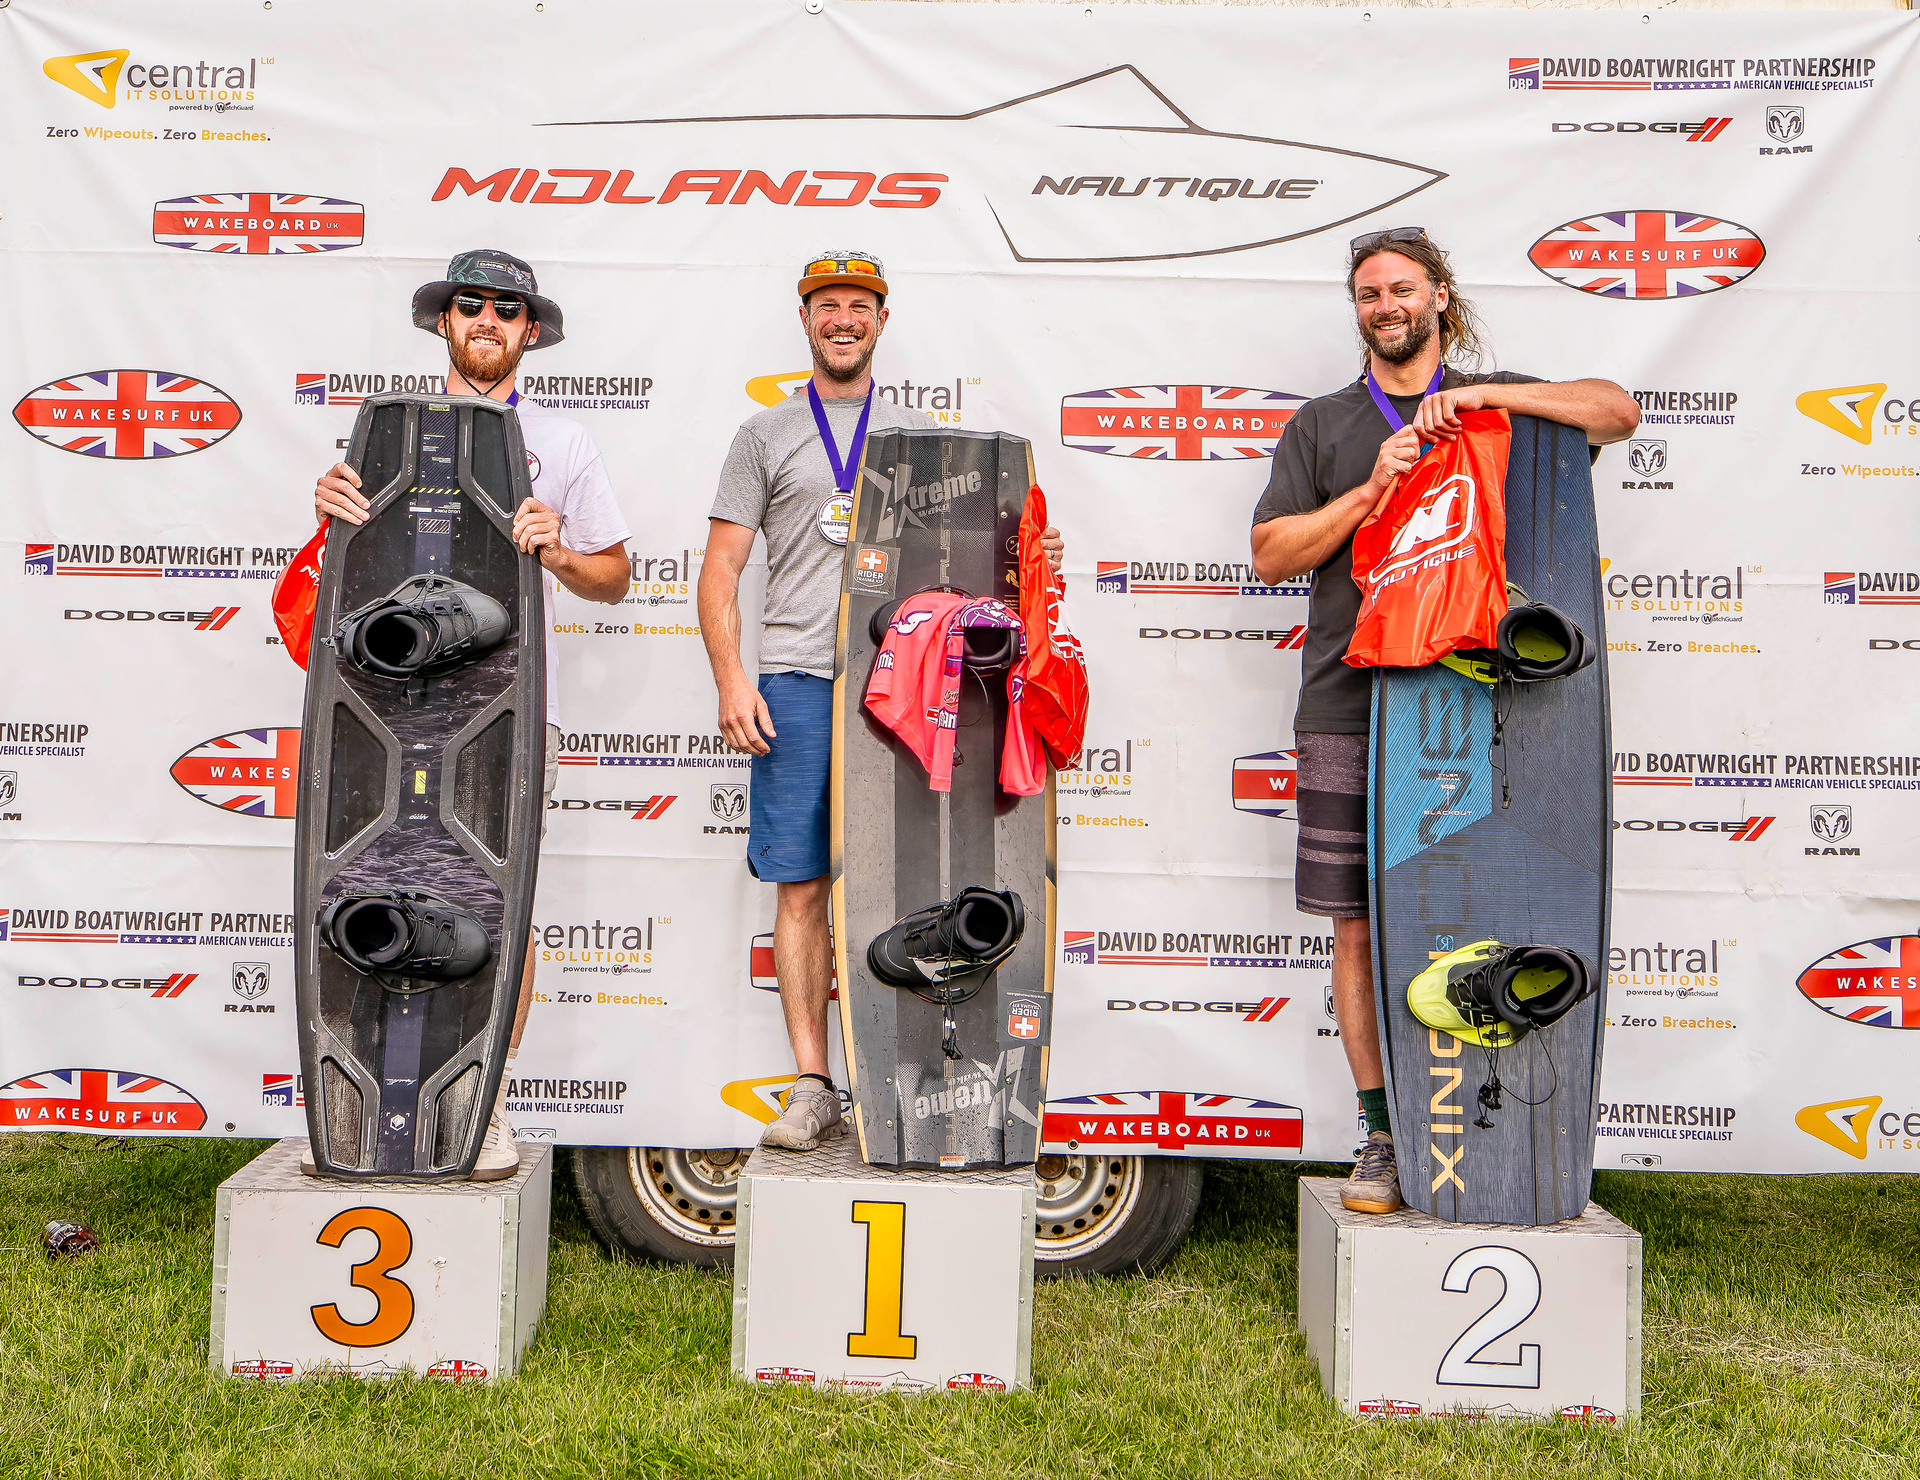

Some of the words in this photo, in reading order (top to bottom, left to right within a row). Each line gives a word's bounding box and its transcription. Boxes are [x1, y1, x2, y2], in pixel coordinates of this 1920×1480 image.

[127, 58, 256, 89] central
[260, 57, 275, 65] Ltd
[1542, 58, 1601, 78] DAVID
[1607, 58, 1736, 79] BOATWRIGHT
[1743, 57, 1876, 78] PARTNERSHIP
[1510, 76, 1535, 90] DBP
[1733, 80, 1780, 90] AMERICAN
[1782, 80, 1819, 91] VEHICLE
[1821, 78, 1875, 91] SPECIALIST
[127, 90, 142, 101] IT
[149, 89, 255, 101] SOLUTIONS
[169, 104, 202, 112] powered
[204, 104, 213, 112] by
[46, 127, 79, 138] Zero
[84, 127, 158, 140] Wipeouts.
[163, 129, 197, 140] Zero
[201, 129, 271, 142] Breaches.
[1552, 122, 1707, 134] DODGE
[1759, 145, 1814, 155] RAM
[431, 167, 949, 209] MIDLANDS
[183, 216, 321, 231] WAKEBOARD
[326, 221, 339, 230] UK
[1569, 247, 1703, 262] WAKESURF
[1712, 245, 1739, 260] UK
[329, 374, 386, 393] DAVID
[524, 375, 653, 398] PARTNERSHIP
[296, 393, 320, 405] DBP
[879, 377, 962, 410] ntral
[967, 377, 981, 385] Ltd
[562, 399, 599, 409] VEHICLE
[601, 398, 649, 410] SPECIALIST
[1635, 391, 1738, 412] RTNERSHIP
[52, 407, 180, 422] WAKESURF
[189, 409, 214, 423] UK
[1645, 414, 1682, 425] VEHICLE
[1684, 414, 1735, 426] SPECIALIST
[1096, 414, 1265, 431] WAKEBOARD
[1271, 421, 1286, 430] UK
[1883, 425, 1900, 435] IT
[1801, 463, 1836, 475] Zero
[1841, 464, 1920, 479] Wipeouts.
[1622, 481, 1674, 490] RAM
[831, 504, 850, 521] 1s
[57, 543, 115, 565] DAVID
[120, 545, 245, 567] BOATWRIGHT
[25, 562, 48, 576] DBP
[630, 549, 689, 582] tral
[1131, 561, 1190, 582] DAVID
[240, 569, 280, 580] AMERICA
[857, 569, 884, 580] RIDER
[632, 583, 689, 594] TIONS
[1097, 581, 1121, 593] DBP
[1607, 566, 1743, 600] central
[1747, 564, 1762, 574] Ltd
[1858, 572, 1920, 592] DAVID
[637, 598, 647, 607] by
[1825, 592, 1850, 604] DBP
[1607, 600, 1624, 611] IT
[1630, 600, 1743, 612] SOLUTIONS
[64, 609, 213, 622] DODGE
[1652, 614, 1688, 623] powered
[1690, 614, 1700, 624] by
[553, 623, 590, 635] outs.
[594, 622, 629, 635] Zero
[1139, 627, 1293, 641] DODGE
[1607, 640, 1642, 652] outs.
[1646, 640, 1683, 653] Zero
[1687, 641, 1761, 654] Breaches.
[0, 724, 89, 744] TNERSHIP
[1136, 738, 1151, 747] Ltd
[35, 746, 86, 757] SPECIALIST
[677, 757, 725, 768] AMERICAN
[1646, 753, 1778, 775] BOATWRIGHT
[1785, 755, 1920, 777] PARTNERSHIP
[210, 765, 291, 779] WAKES
[1060, 774, 1132, 786] UTIONS
[1774, 778, 1824, 789] AMERICAN
[1825, 778, 1868, 789] VEHICLE
[1869, 779, 1920, 791] SPECIALIST
[1078, 787, 1089, 797] by
[561, 800, 650, 811] DGE
[1076, 814, 1149, 828] Breaches.
[1614, 820, 1750, 833] ODGE
[703, 825, 750, 834] RAM
[1804, 847, 1861, 856] RAM
[12, 909, 69, 930] DAVID
[75, 910, 203, 932] BOATWRIGHT
[210, 913, 294, 933] PARTNER
[658, 916, 672, 925] Ltd
[199, 936, 247, 947] AMERICAN
[249, 936, 286, 947] VEHICLE
[1098, 931, 1157, 952] DAVID
[1163, 932, 1292, 955] BOATWRIGHT
[542, 950, 653, 963] SOLUTIONS
[1065, 952, 1089, 964] DBP
[1608, 939, 1718, 974] entral
[1722, 939, 1737, 947] Ltd
[563, 965, 598, 974] powered
[600, 965, 610, 975] by
[1289, 959, 1332, 969] AMERICA
[18, 976, 171, 989] DODGE
[1837, 976, 1918, 990] WAKES
[557, 991, 592, 1003] Zero
[597, 991, 668, 1006] Breaches.
[1626, 988, 1662, 998] powered
[1664, 989, 1674, 998] by
[224, 1004, 276, 1013] RAM
[1011, 1008, 1039, 1018] RIDER
[1107, 1000, 1263, 1013] DODGE
[1621, 1015, 1657, 1028] Zero
[1662, 1017, 1737, 1029] Breaches.
[506, 1079, 628, 1101] ARTNERSHIP
[263, 1094, 287, 1107] DBP
[505, 1101, 533, 1112] RICAN
[535, 1102, 572, 1113] VEHICLE
[574, 1103, 624, 1114] SPECIALIST
[15, 1107, 142, 1124] WAKESURF
[152, 1110, 178, 1124] UK
[1078, 1121, 1249, 1139] WAKEBOARD
[1255, 1129, 1271, 1138] UK
[1637, 1128, 1677, 1139] VEHICLE
[1679, 1129, 1733, 1141] SPECIALIST
[1879, 1139, 1896, 1150] IT
[310, 1206, 415, 1347] 3
[846, 1200, 917, 1359] 1
[1436, 1245, 1542, 1389] 2
